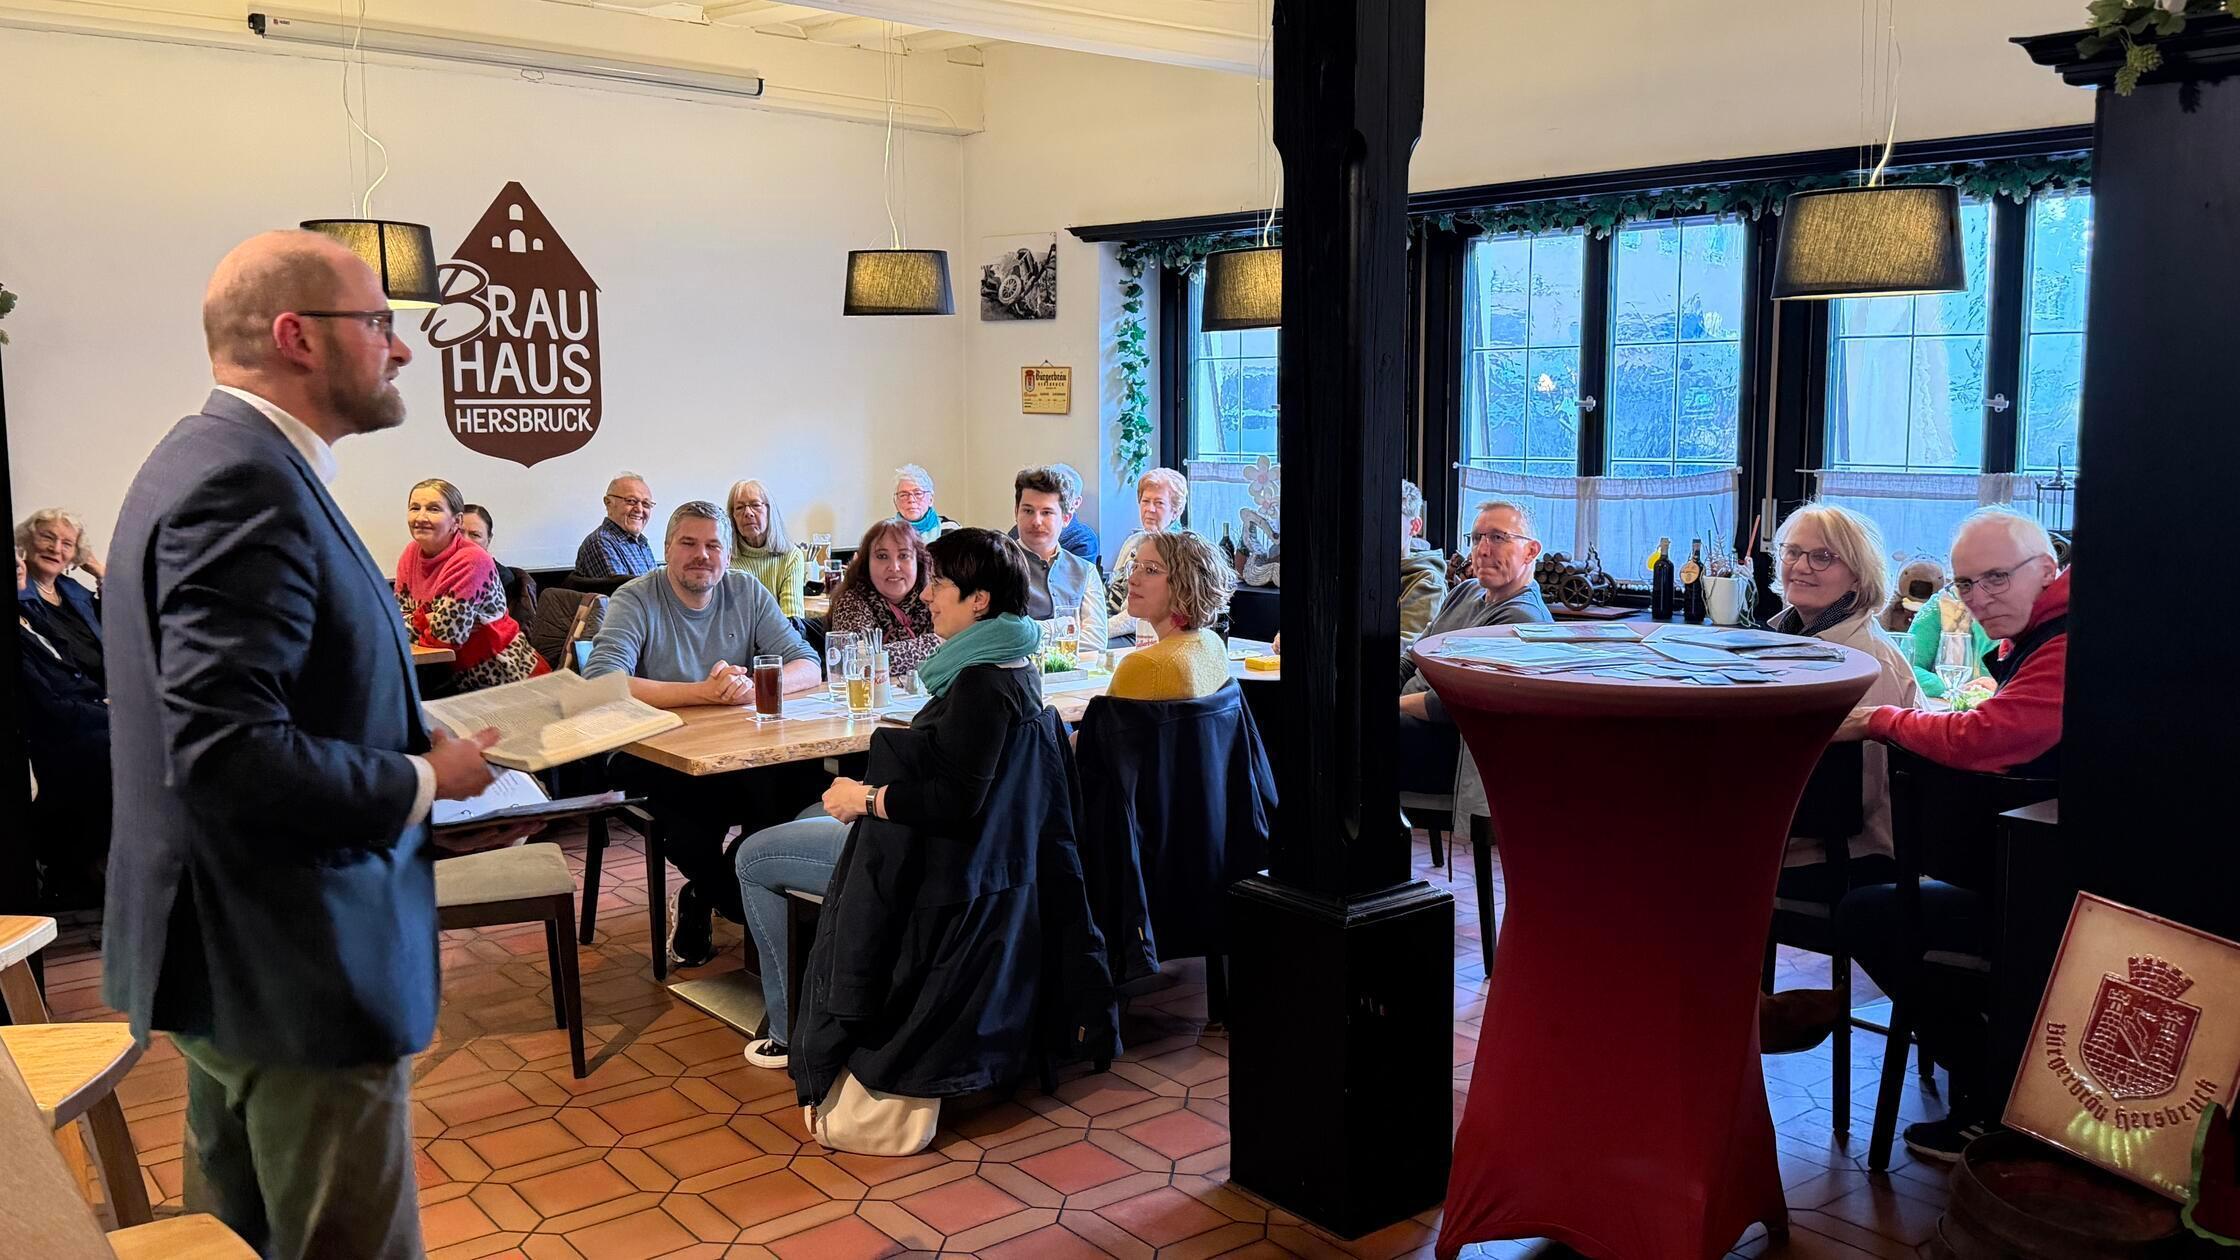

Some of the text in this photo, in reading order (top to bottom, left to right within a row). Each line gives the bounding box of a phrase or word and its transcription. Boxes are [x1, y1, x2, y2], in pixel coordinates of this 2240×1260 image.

[421, 263, 589, 349] BRAU
[453, 341, 592, 395] HAUS
[455, 408, 593, 433] HERSBRUCK
[2115, 1079, 2217, 1131] Hersbruck
